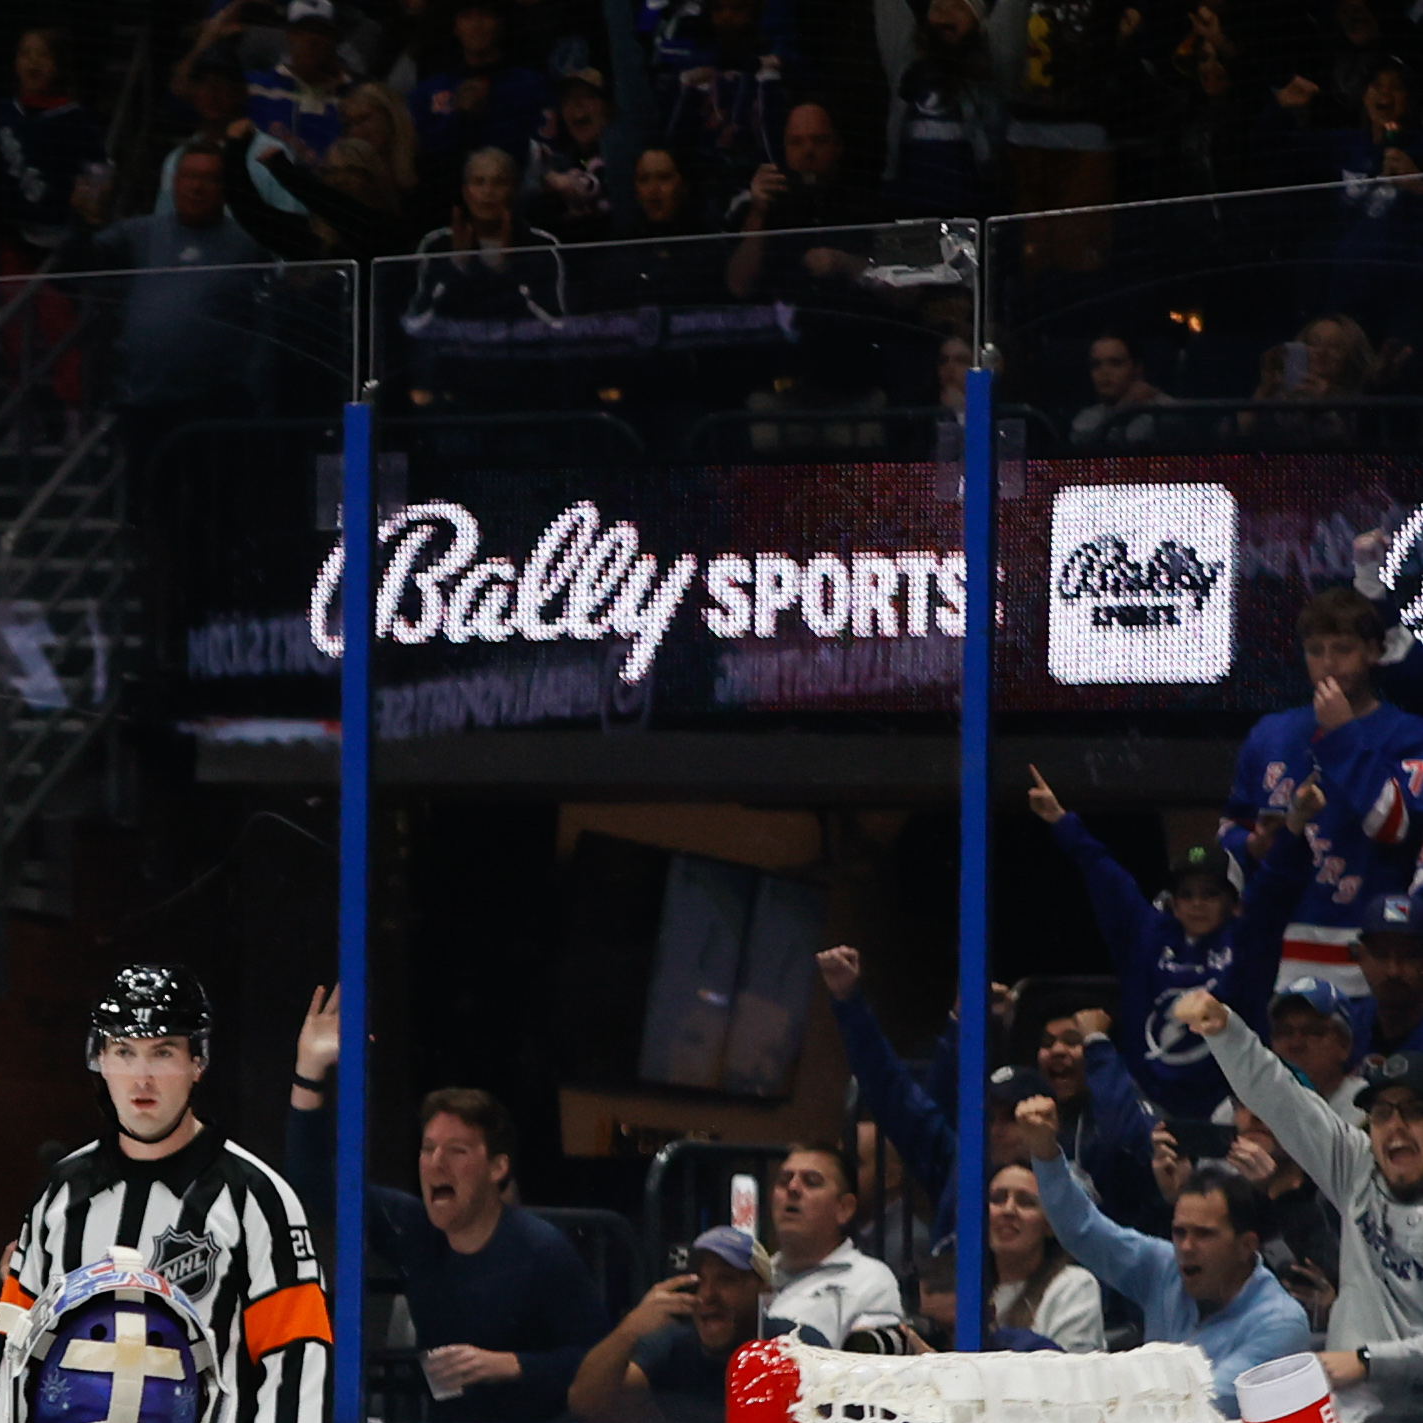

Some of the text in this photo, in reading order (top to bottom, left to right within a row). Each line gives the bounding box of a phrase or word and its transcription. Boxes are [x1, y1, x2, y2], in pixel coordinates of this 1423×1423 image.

[309, 501, 696, 684] Bally
[701, 550, 1006, 640] SPORTS
[165, 1250, 208, 1281] NHL
